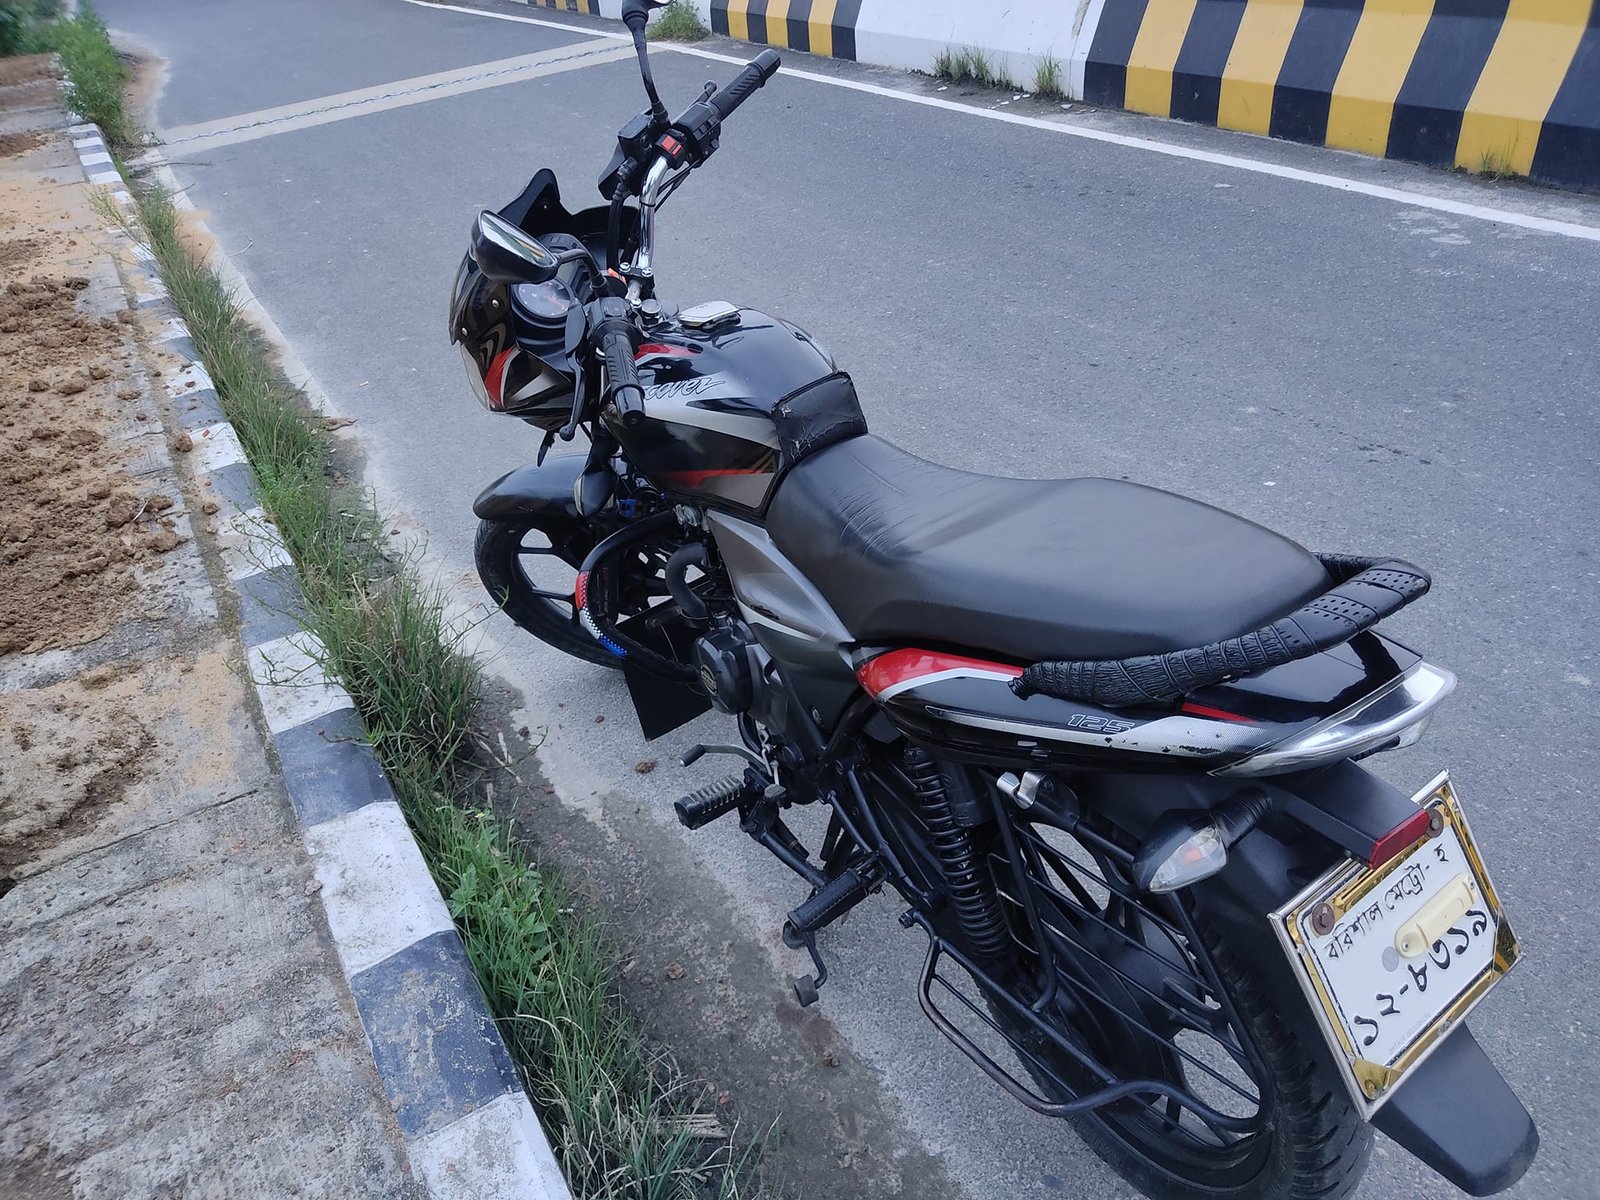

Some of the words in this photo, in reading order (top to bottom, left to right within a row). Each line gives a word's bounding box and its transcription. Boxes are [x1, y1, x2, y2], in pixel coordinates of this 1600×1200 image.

[645, 377, 726, 401] cover
[1067, 713, 1136, 734] 125
[1322, 901, 1383, 960] বরিশাল
